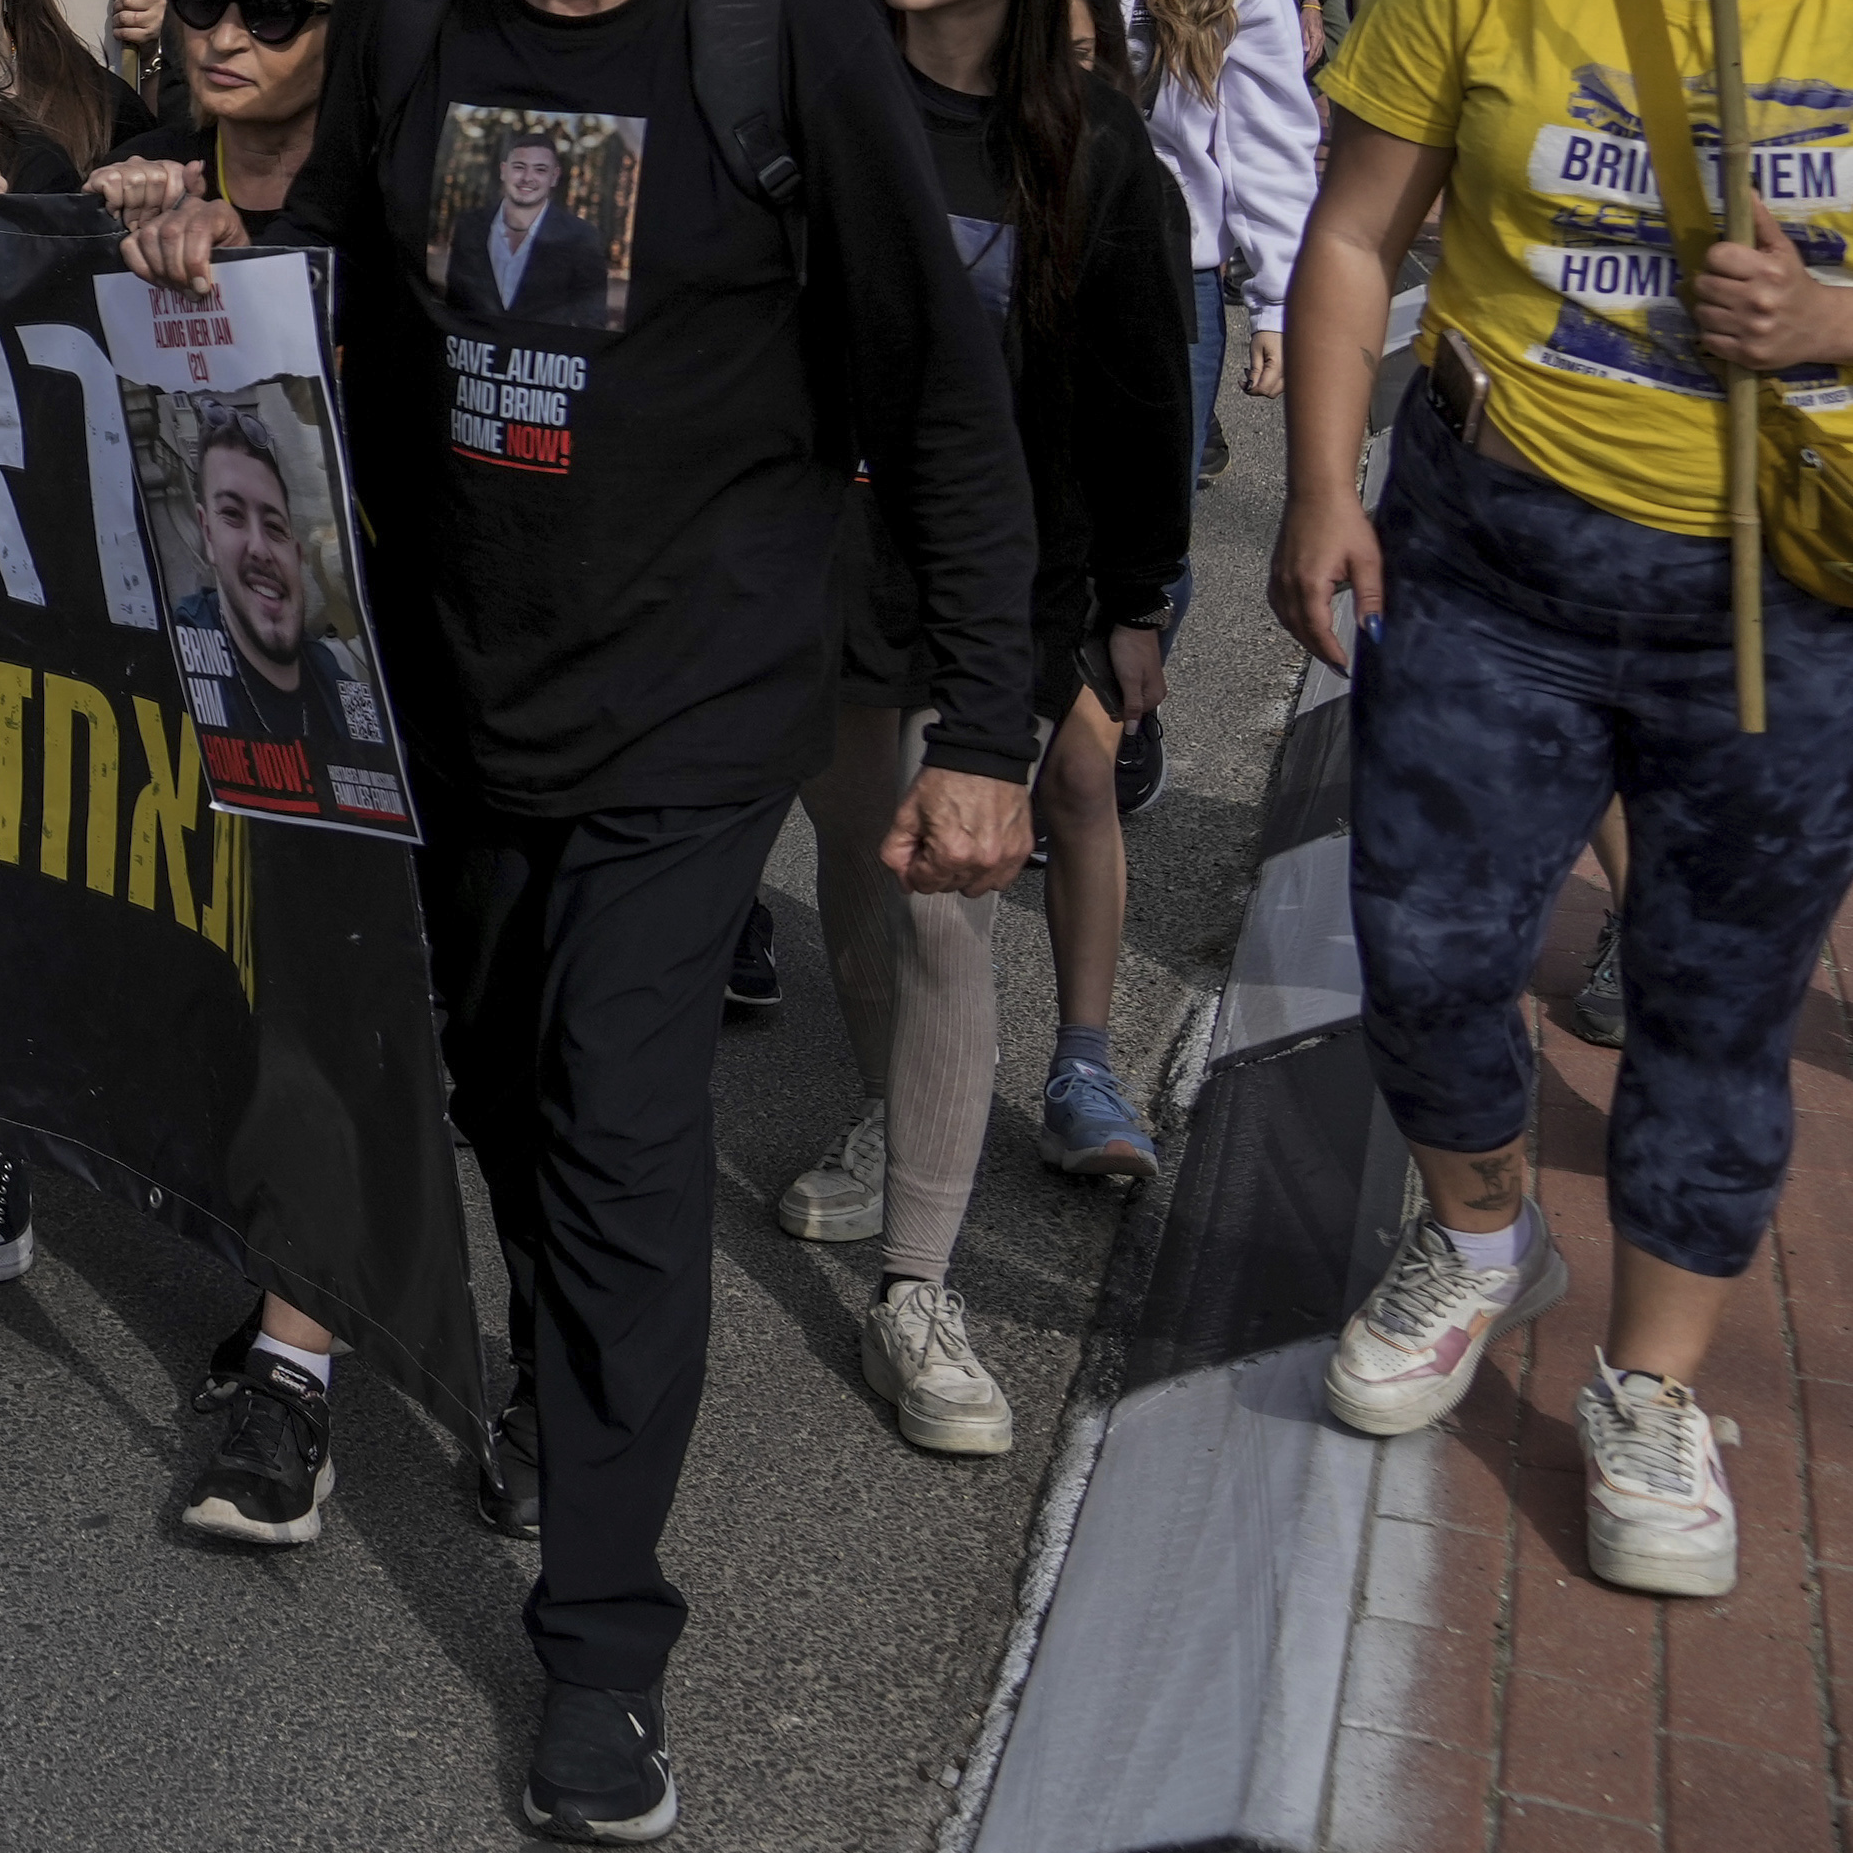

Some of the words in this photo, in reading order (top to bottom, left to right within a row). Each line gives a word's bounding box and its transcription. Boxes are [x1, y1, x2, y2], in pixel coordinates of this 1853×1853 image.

[188, 350, 209, 383] (21)
[445, 333, 587, 392] SAVE_ALMOG
[456, 369, 497, 416] AND
